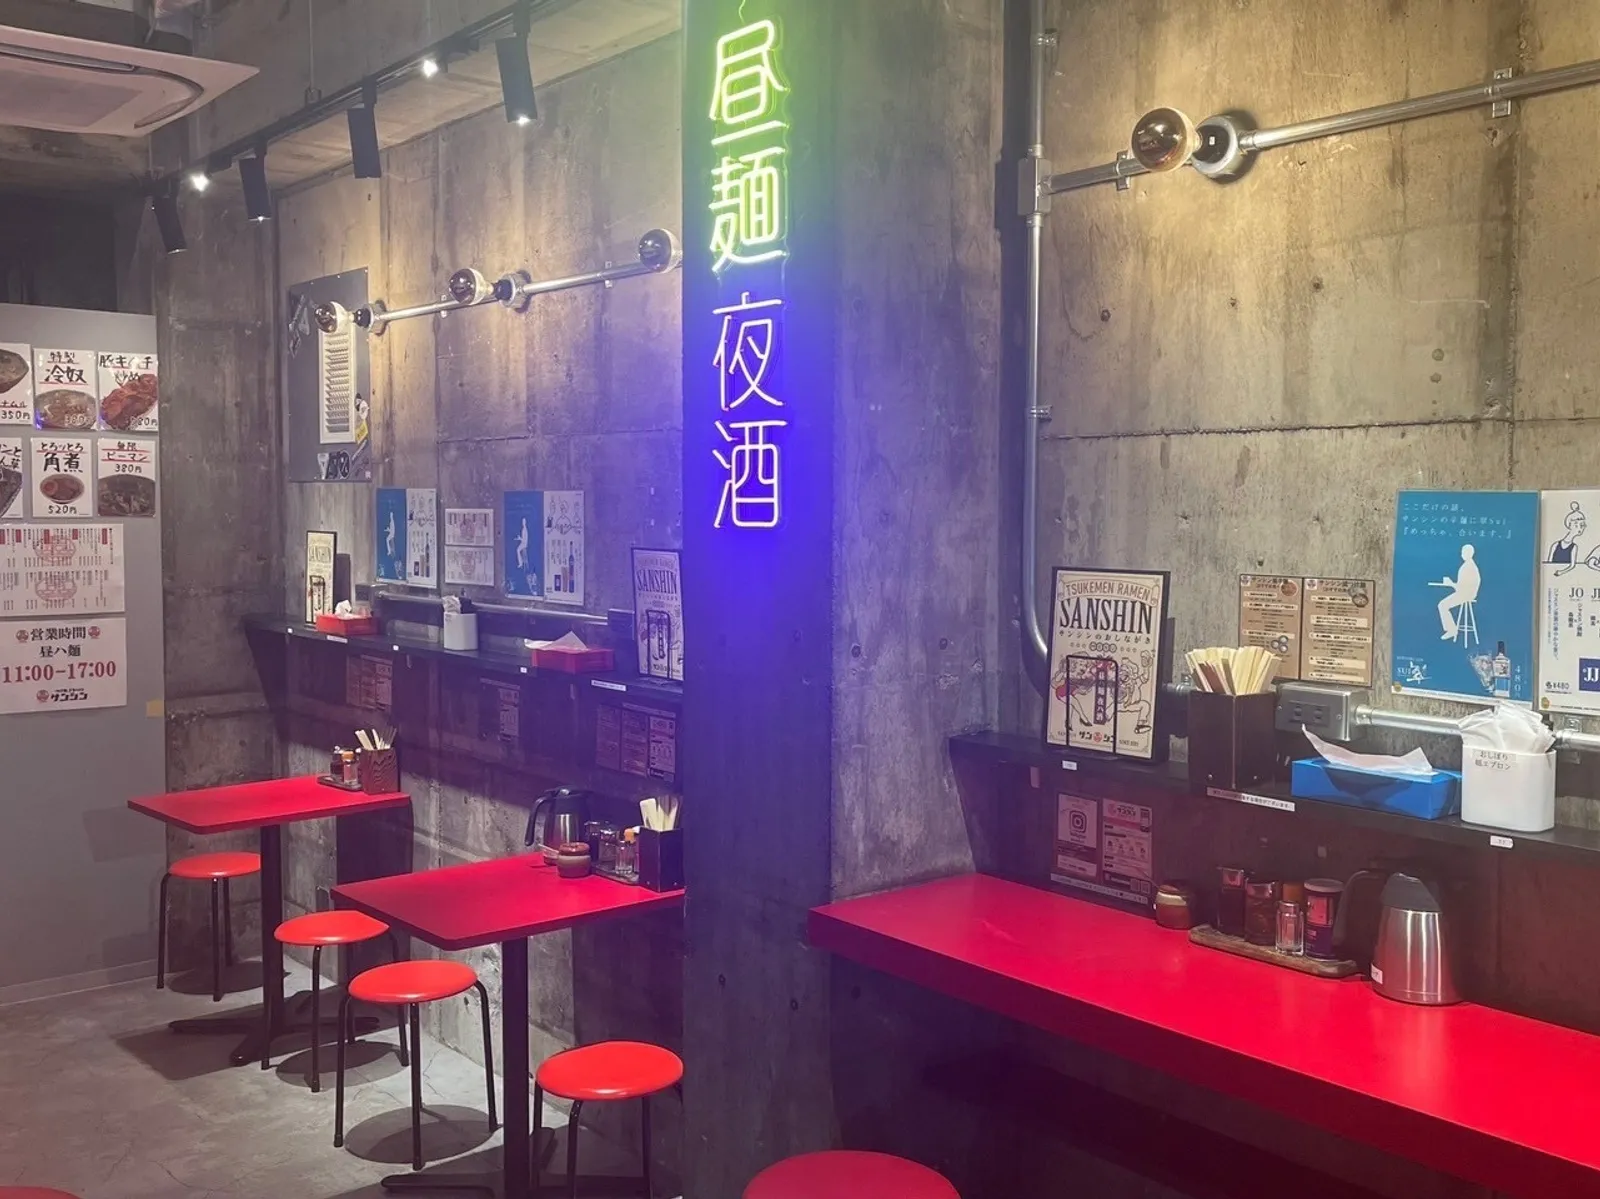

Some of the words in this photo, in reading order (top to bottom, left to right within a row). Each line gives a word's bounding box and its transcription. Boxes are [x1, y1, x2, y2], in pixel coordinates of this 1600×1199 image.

[45, 365, 87, 383] 冷奴
[1, 410, 30, 420] 350円
[0, 443, 22, 457] ンと
[44, 453, 84, 473] 角煮
[107, 452, 148, 462] ピーマン
[115, 464, 142, 475] 380円
[48, 505, 78, 517] 520円
[637, 569, 677, 594] SANSHIN
[1066, 581, 1114, 598] TSUKEMEN
[1117, 584, 1151, 603] RAMEN
[1569, 587, 1584, 598] JO
[1060, 597, 1152, 635] SANSHIN
[31, 626, 87, 642] 営業時間
[51, 692, 88, 702] サンシン
[1480, 751, 1508, 761] おしぼり
